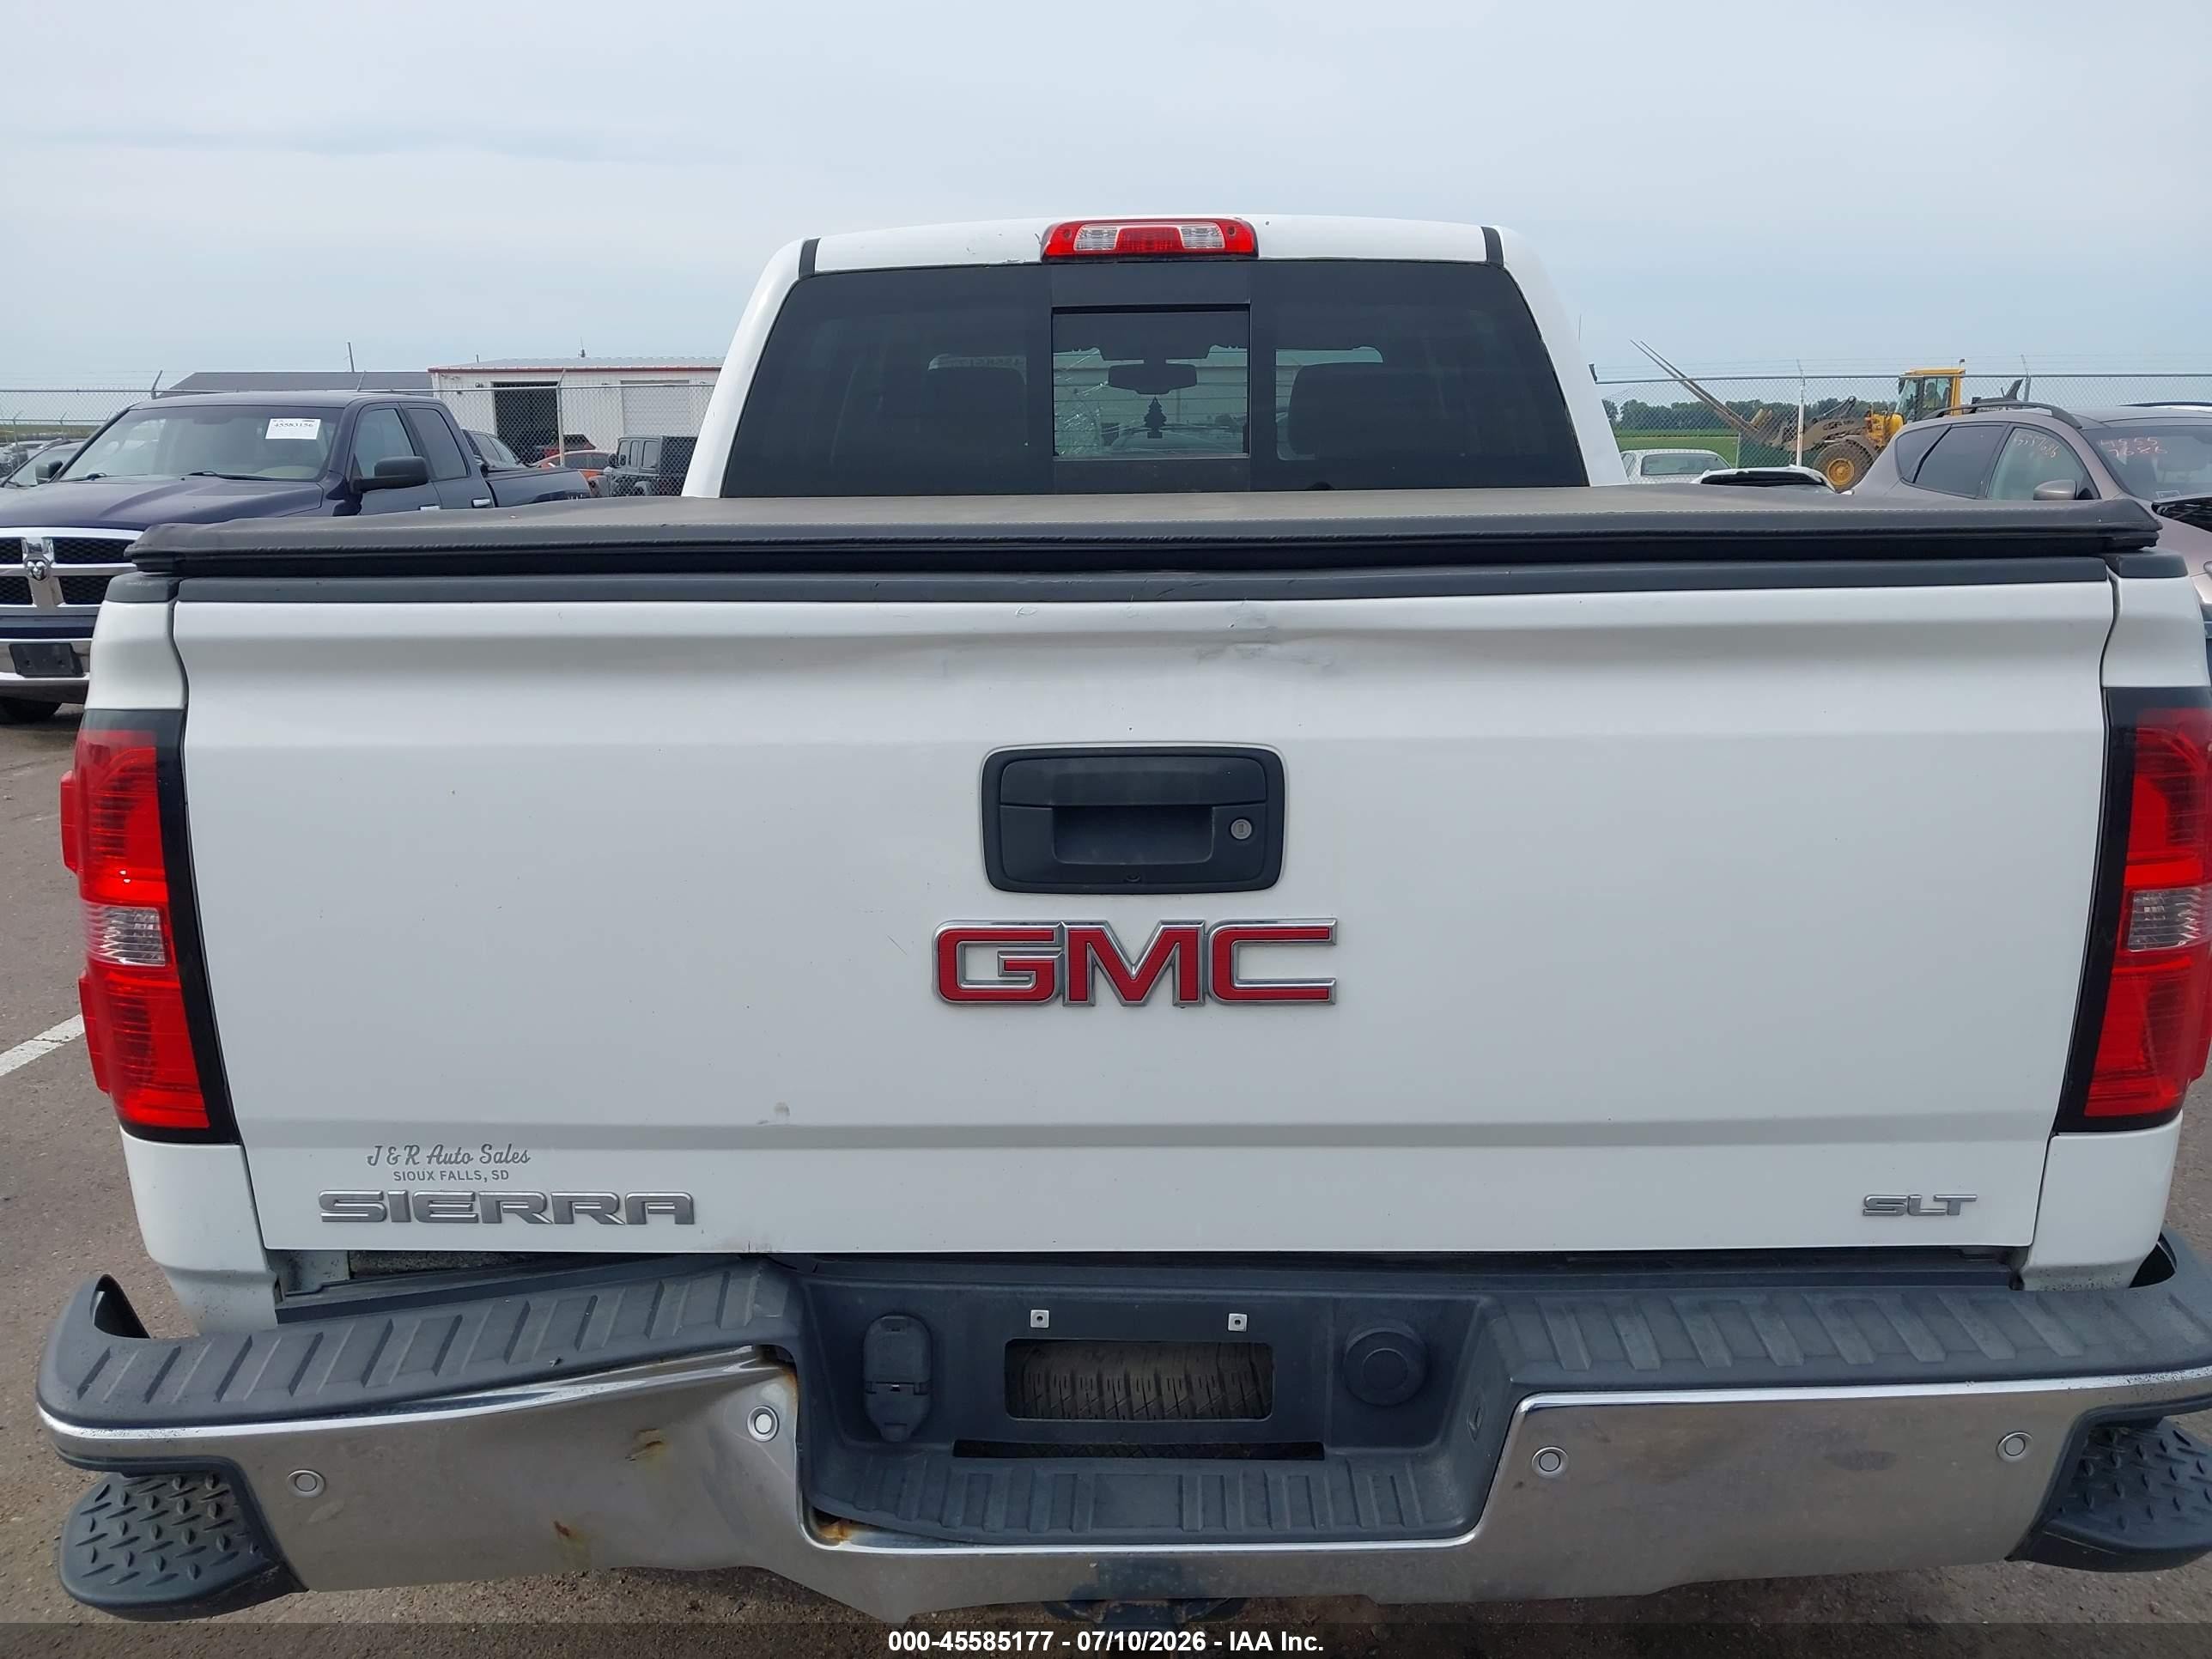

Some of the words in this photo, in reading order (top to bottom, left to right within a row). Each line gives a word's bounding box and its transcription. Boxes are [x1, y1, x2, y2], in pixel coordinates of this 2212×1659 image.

[933, 918, 1338, 1007] GMC
[426, 1144, 475, 1165] Auto
[479, 1143, 532, 1164] Sales
[393, 1170, 435, 1182] SIOUX
[440, 1170, 488, 1183] FALLS,
[491, 1170, 509, 1181] SD
[319, 1189, 696, 1225] SIERRA
[1863, 1194, 1978, 1217] SLT
